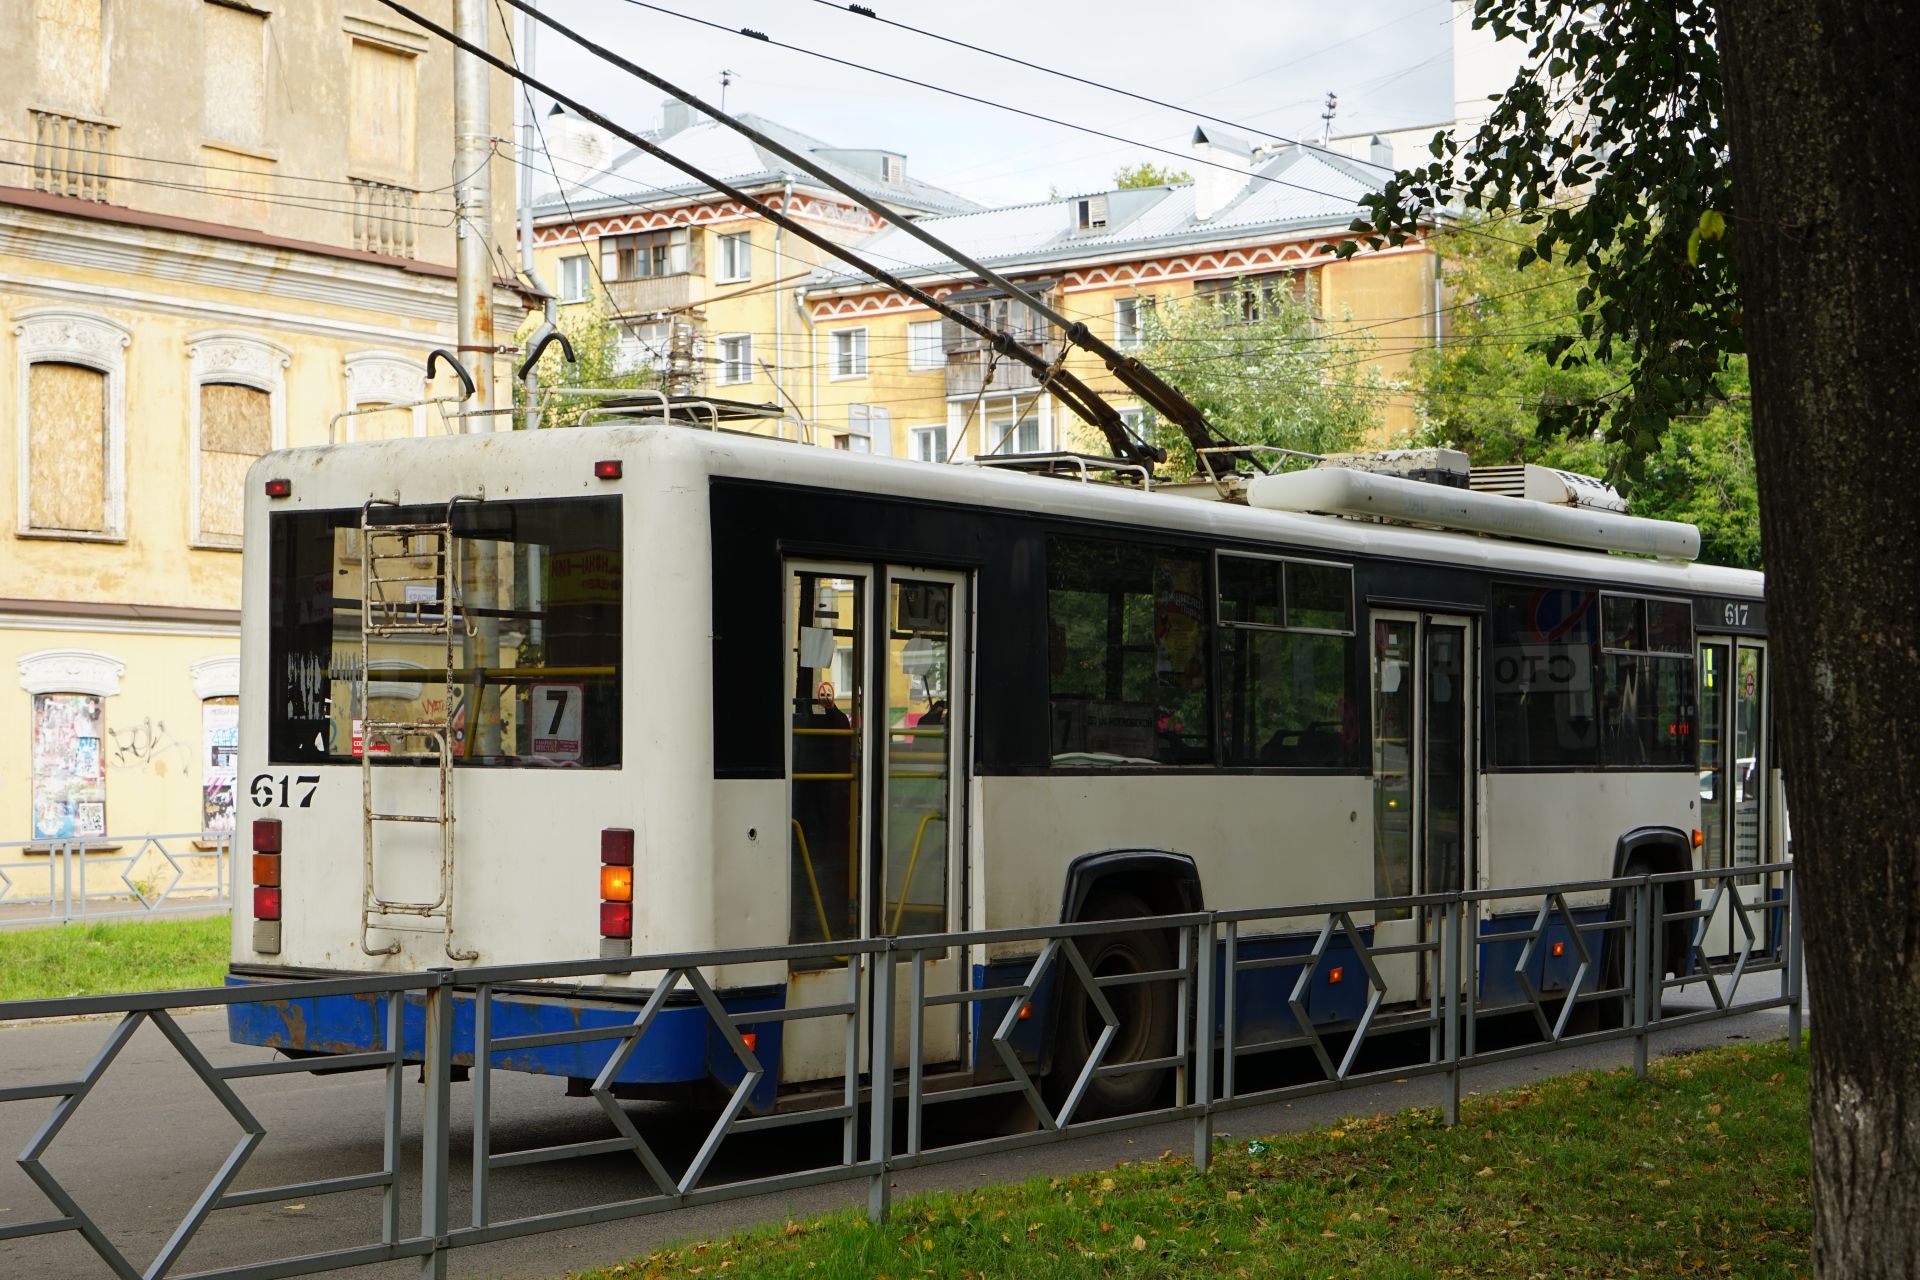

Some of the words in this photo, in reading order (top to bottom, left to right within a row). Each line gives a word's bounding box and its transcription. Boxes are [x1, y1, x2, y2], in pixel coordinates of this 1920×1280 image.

[1724, 603, 1749, 626] 617
[546, 690, 568, 735] 7
[1057, 710, 1073, 749] 7
[250, 774, 321, 809] 617
